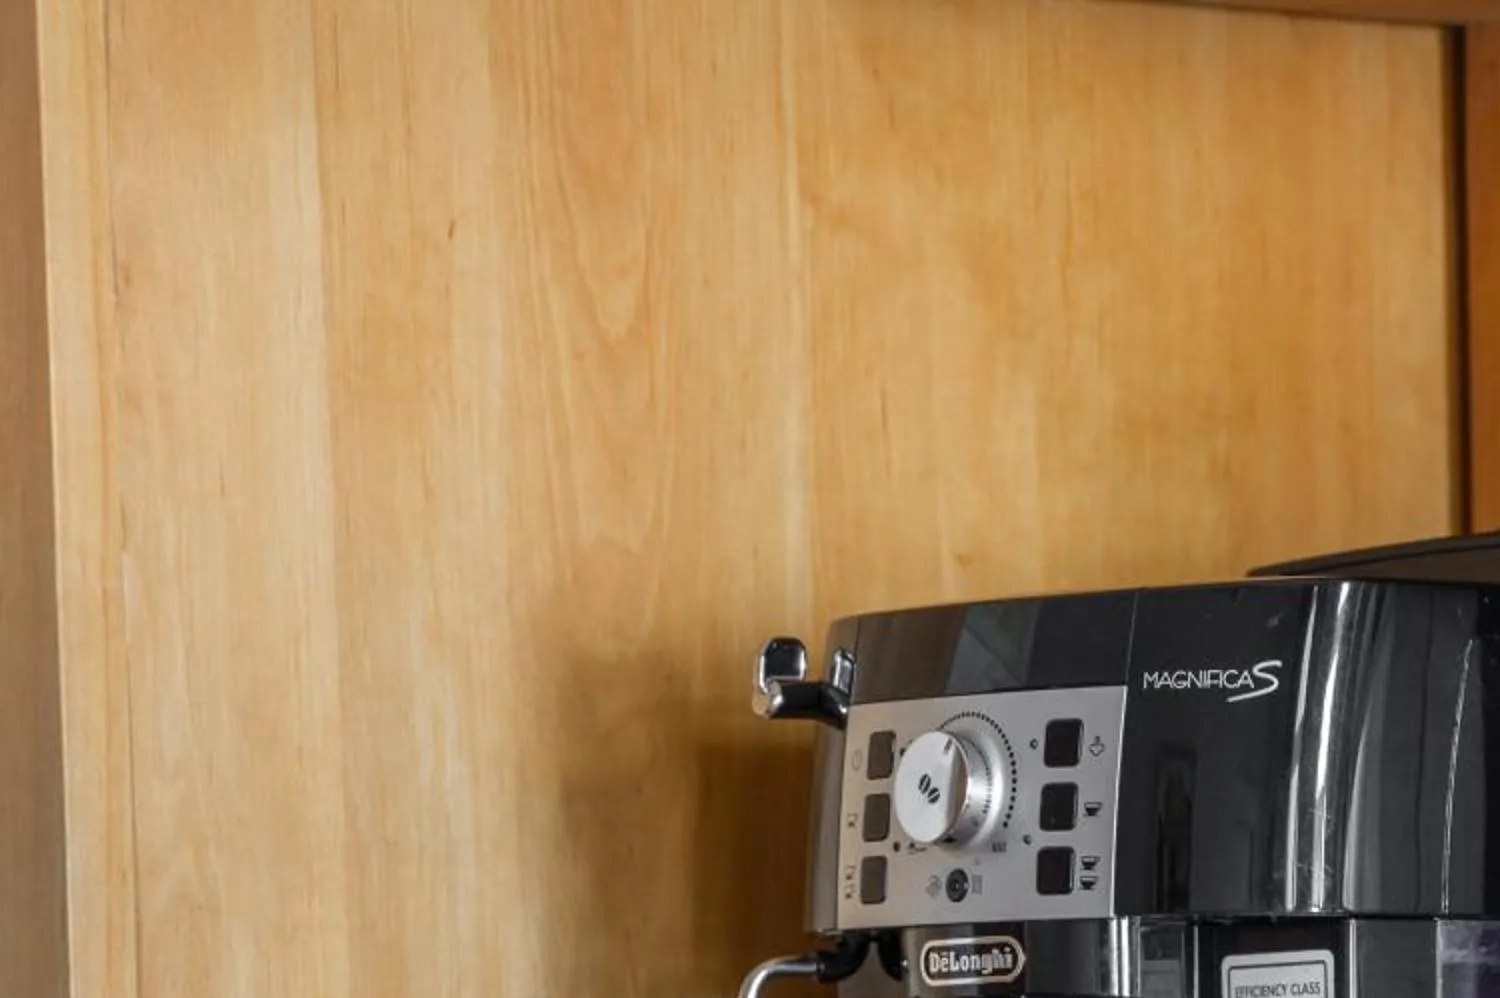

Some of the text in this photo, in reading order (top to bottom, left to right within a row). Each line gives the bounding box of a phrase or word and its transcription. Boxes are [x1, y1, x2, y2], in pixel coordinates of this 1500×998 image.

[1143, 659, 1283, 702] MAGNIFICA S
[1235, 981, 1321, 998] EFFICIENCY CLASS
